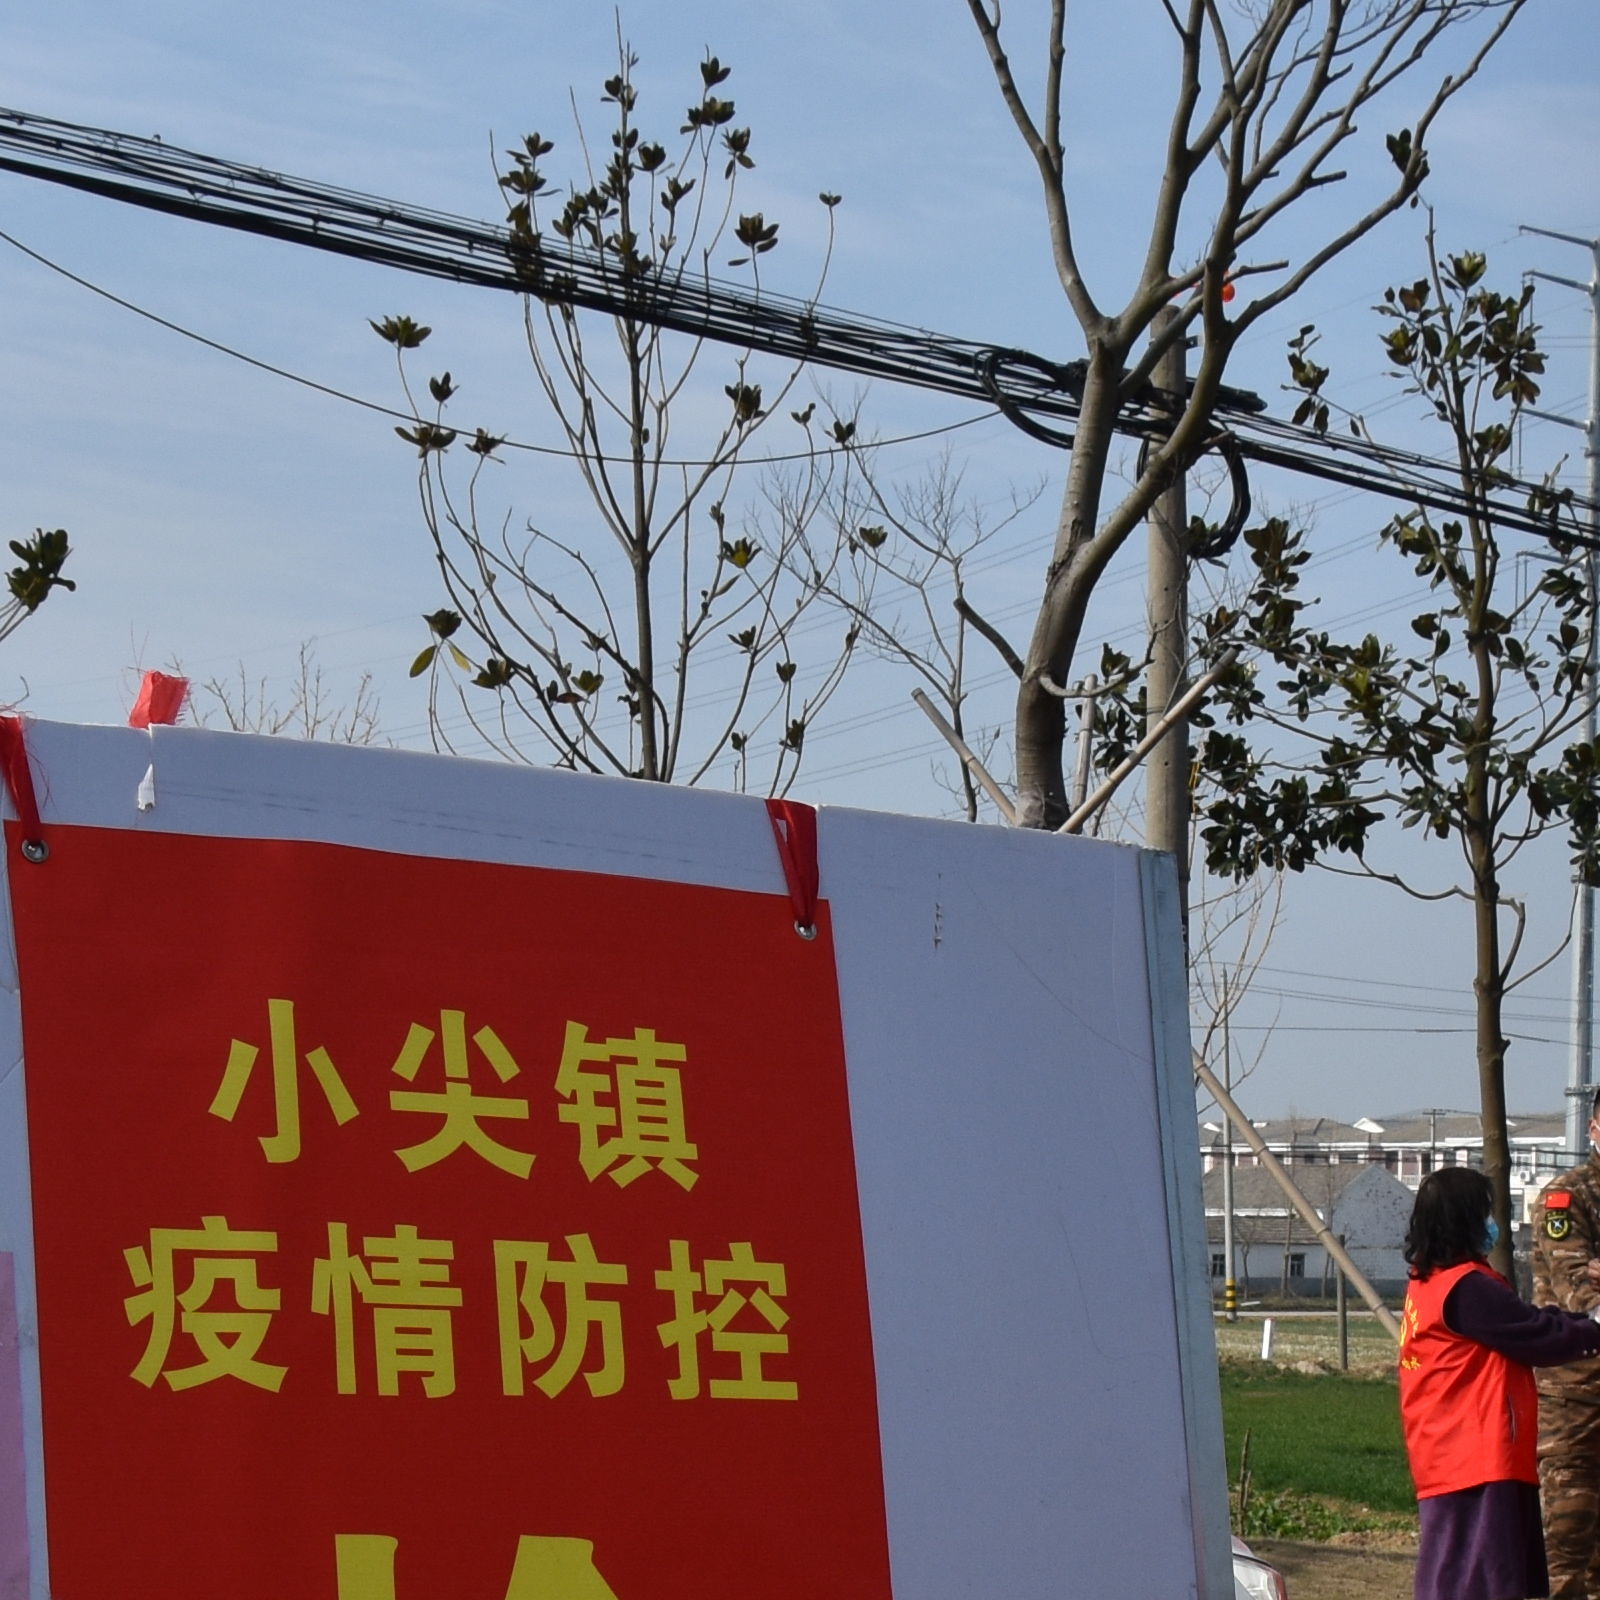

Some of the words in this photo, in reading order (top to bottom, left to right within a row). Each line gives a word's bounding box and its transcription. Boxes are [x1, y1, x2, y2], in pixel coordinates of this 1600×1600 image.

[208, 998, 700, 1192] 小尖镇
[123, 1215, 800, 1402] 疫情防控
